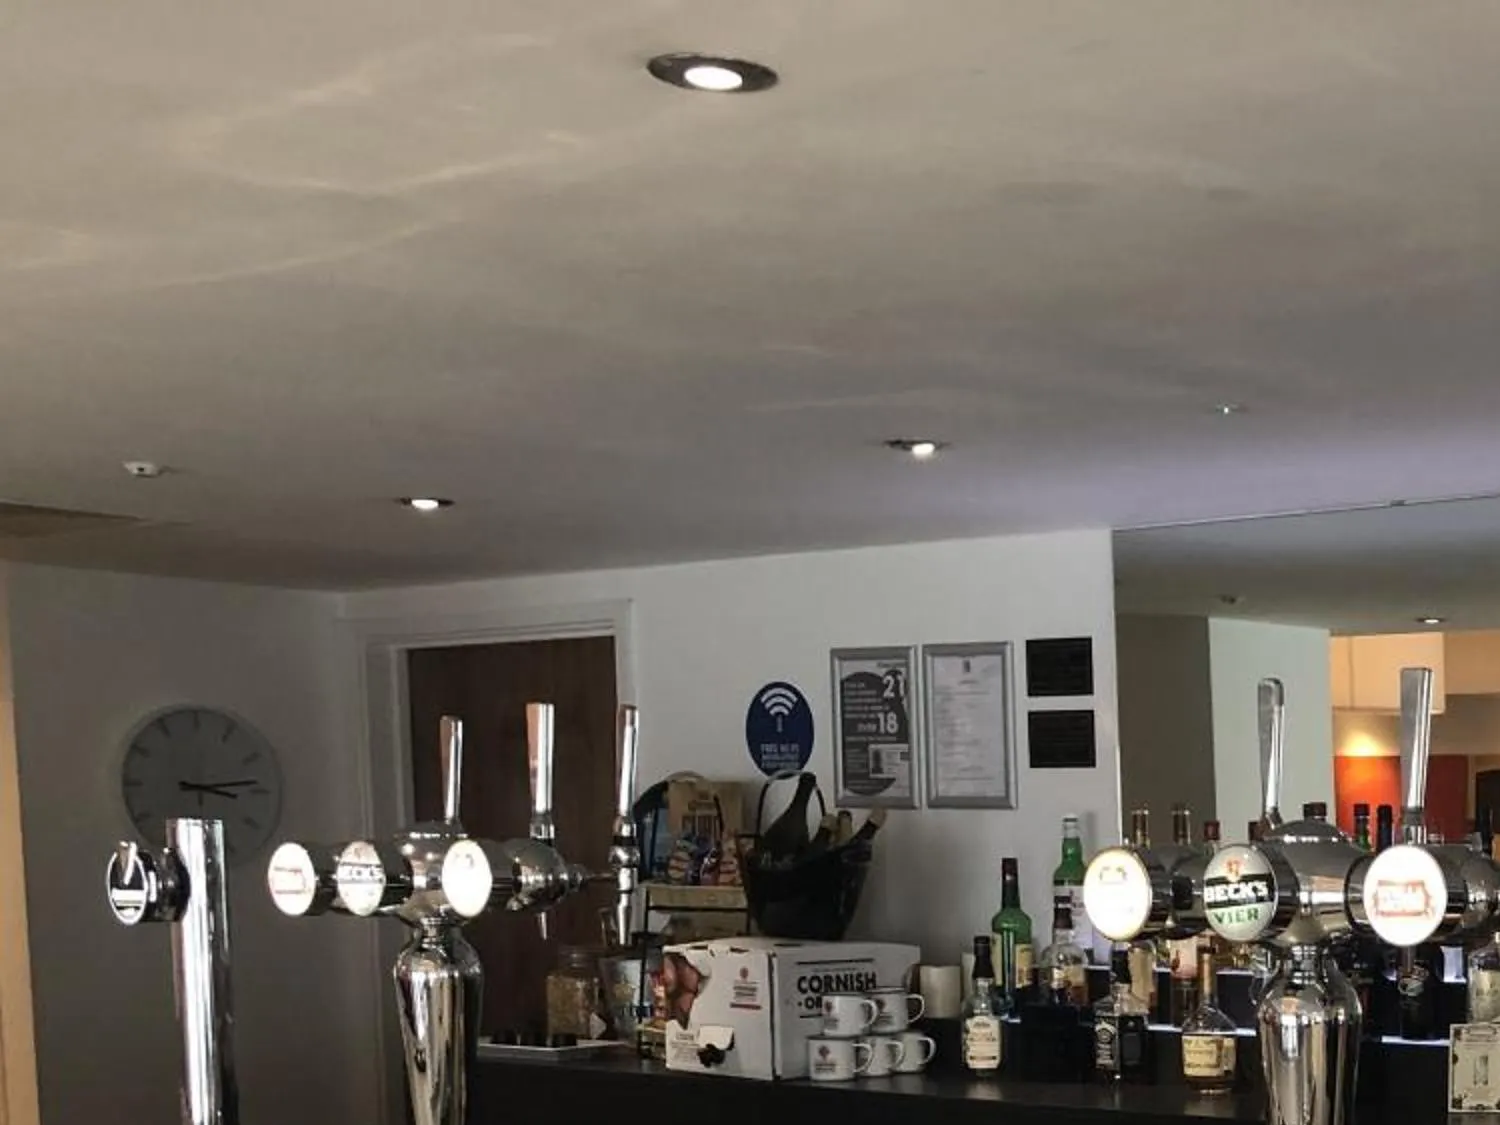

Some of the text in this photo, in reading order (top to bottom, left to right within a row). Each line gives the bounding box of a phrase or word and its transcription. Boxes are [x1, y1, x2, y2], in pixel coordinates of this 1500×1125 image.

[877, 711, 898, 735] 18
[1213, 909, 1261, 926] VIER
[796, 972, 876, 994] CORNISH
